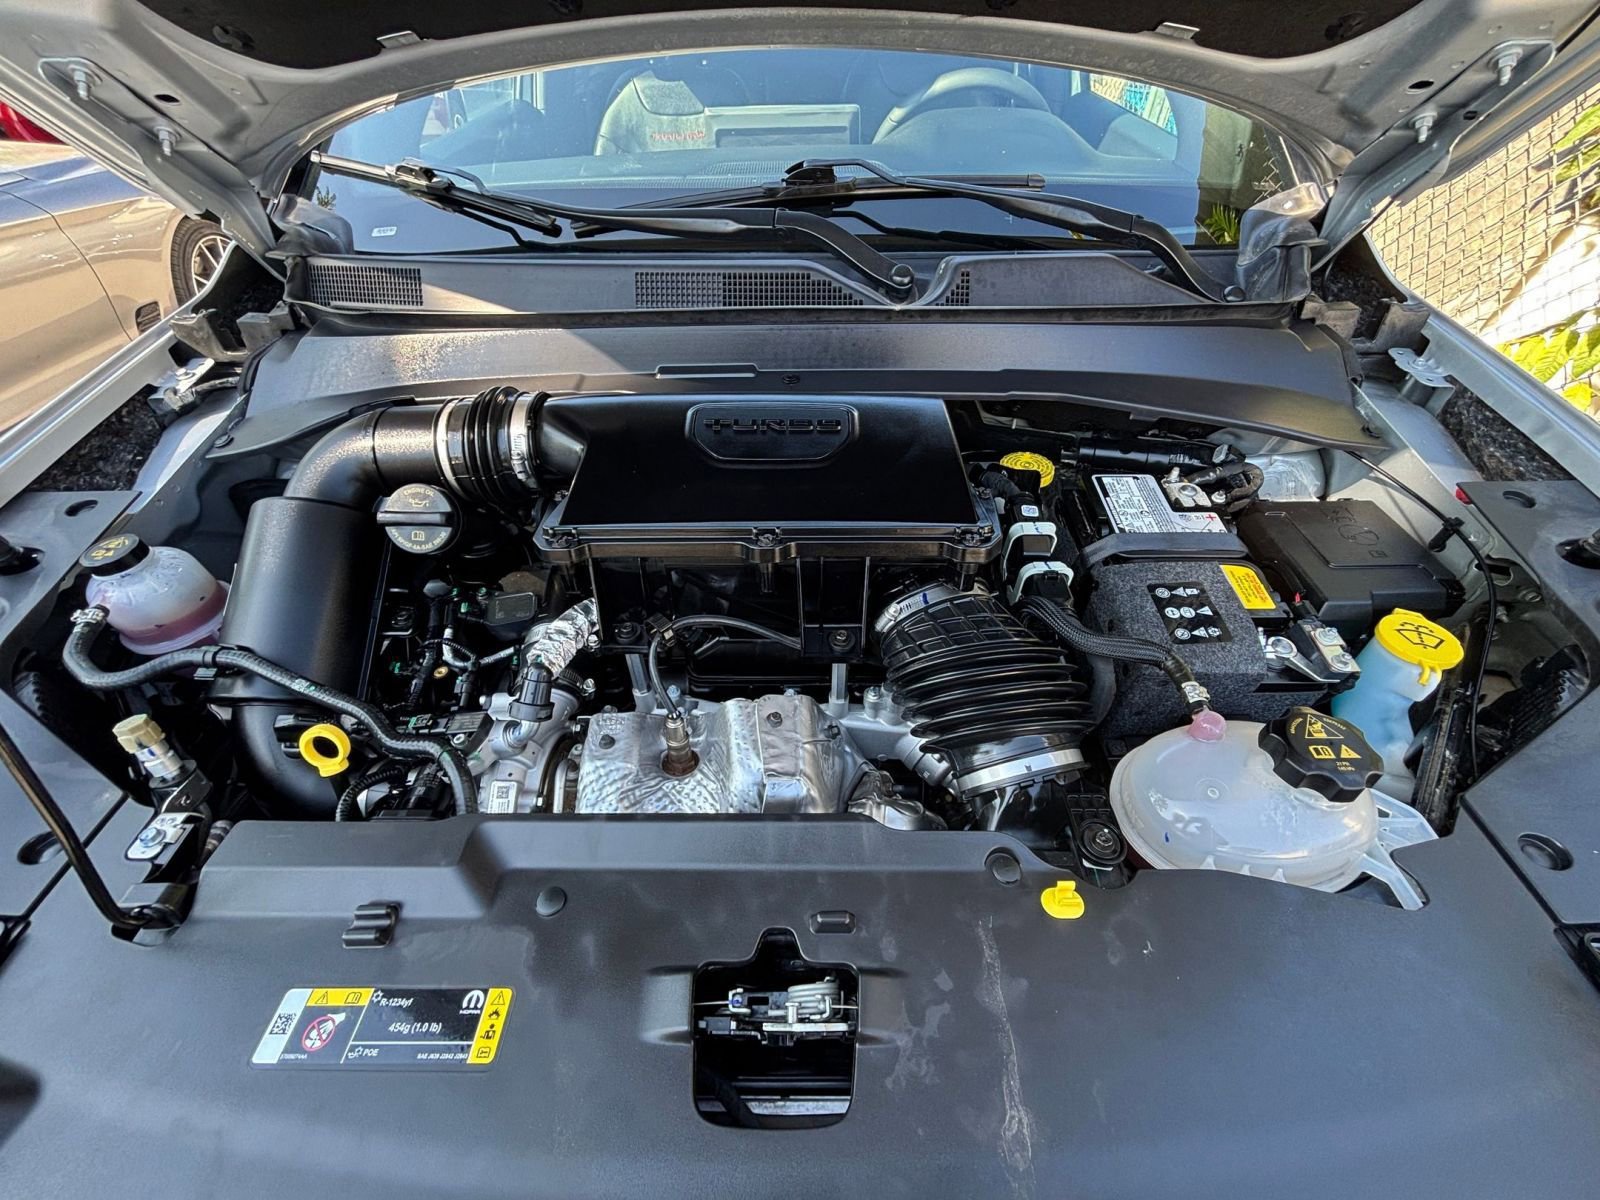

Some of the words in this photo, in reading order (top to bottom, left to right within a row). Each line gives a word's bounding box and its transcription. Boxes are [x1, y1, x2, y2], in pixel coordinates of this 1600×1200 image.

[703, 418, 842, 432] TURBO
[403, 487, 425, 496] ENGINE
[425, 487, 435, 497] OIL
[379, 997, 414, 1008] R-1234yf
[388, 1022, 411, 1034] 454g
[411, 1022, 429, 1034] (1.0
[429, 1022, 442, 1034] lb)
[362, 1048, 380, 1056] POE
